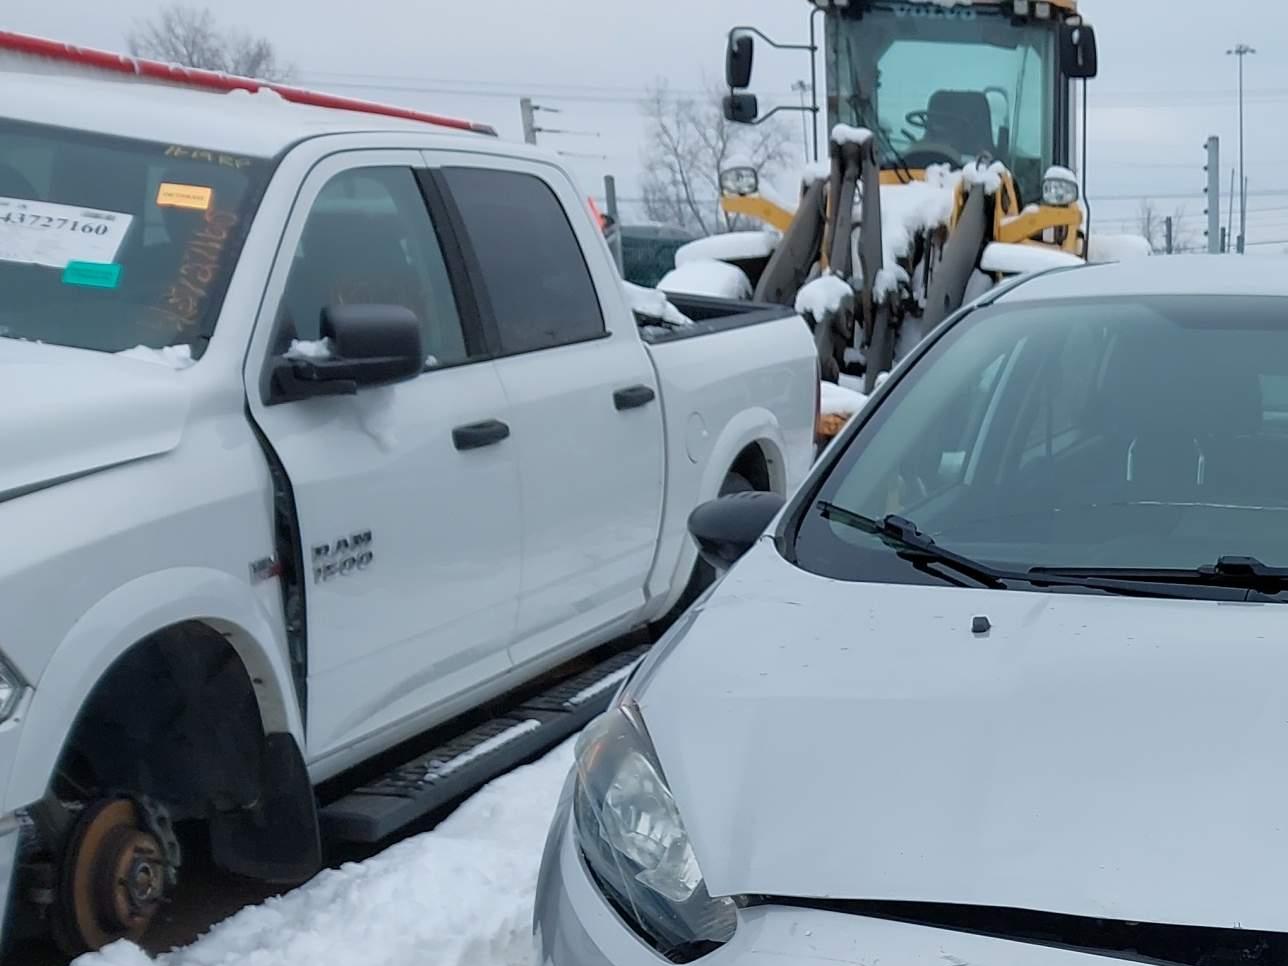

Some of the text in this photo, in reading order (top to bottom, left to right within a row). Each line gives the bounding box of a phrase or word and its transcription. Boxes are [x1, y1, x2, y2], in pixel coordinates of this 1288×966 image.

[0, 210, 109, 236] 43727160
[311, 530, 373, 561] RAM
[313, 551, 374, 585] 1500
